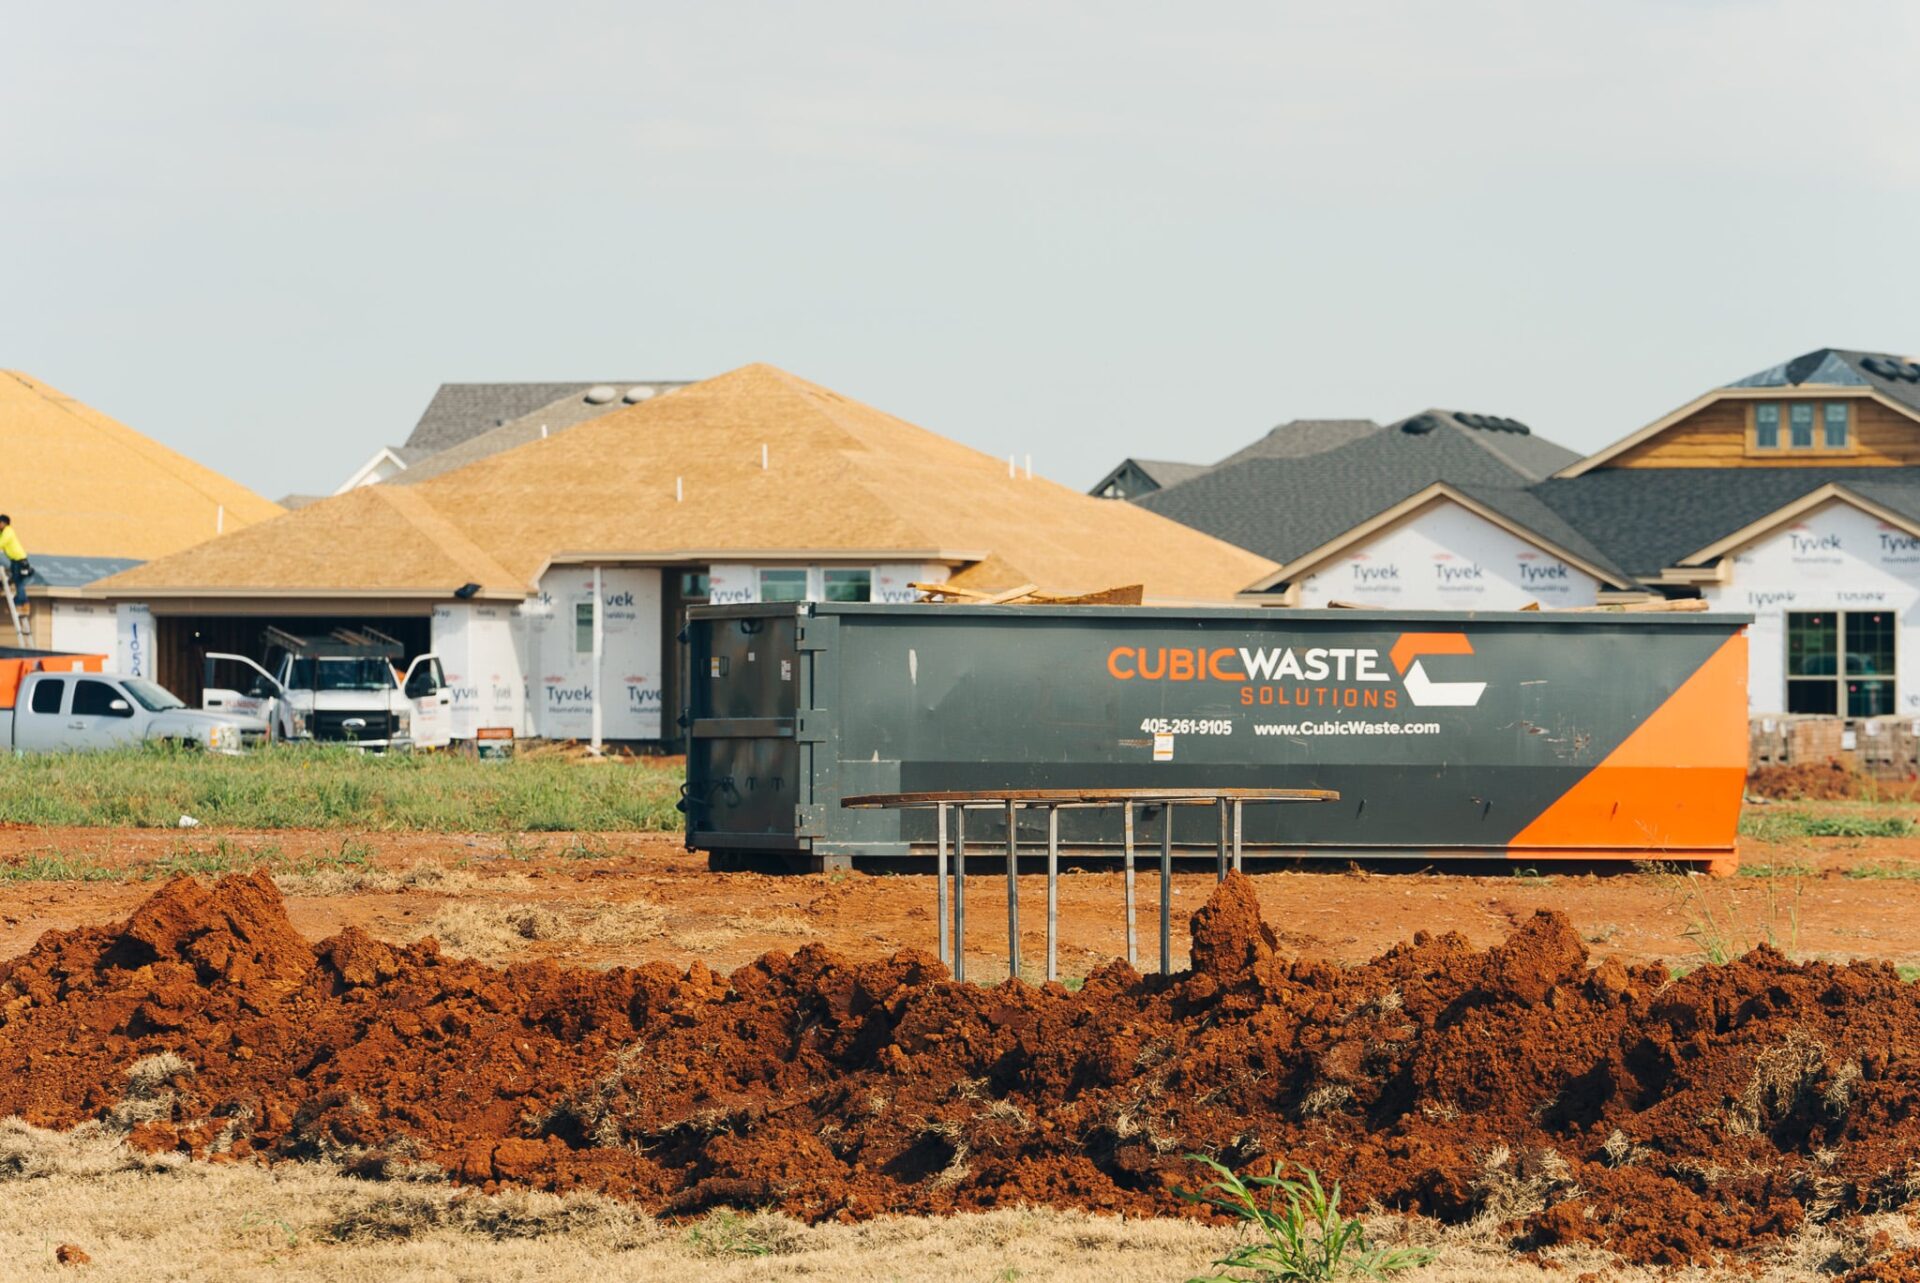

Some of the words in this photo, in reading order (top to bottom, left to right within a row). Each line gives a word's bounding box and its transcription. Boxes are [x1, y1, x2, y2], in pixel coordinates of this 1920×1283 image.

[1790, 533, 1842, 552] Tyvek
[1879, 534, 1920, 553] Tyve
[1352, 563, 1398, 582] Tyvek
[1435, 563, 1482, 582] Tyvek
[1518, 563, 1567, 582] Tyvek
[546, 686, 593, 704] Tyvek
[627, 686, 663, 704] Tyve
[1240, 686, 1398, 709] SOLUTIONS
[1140, 718, 1233, 735] 405-261-9105
[1253, 721, 1441, 736] www.CubicWaste.com
